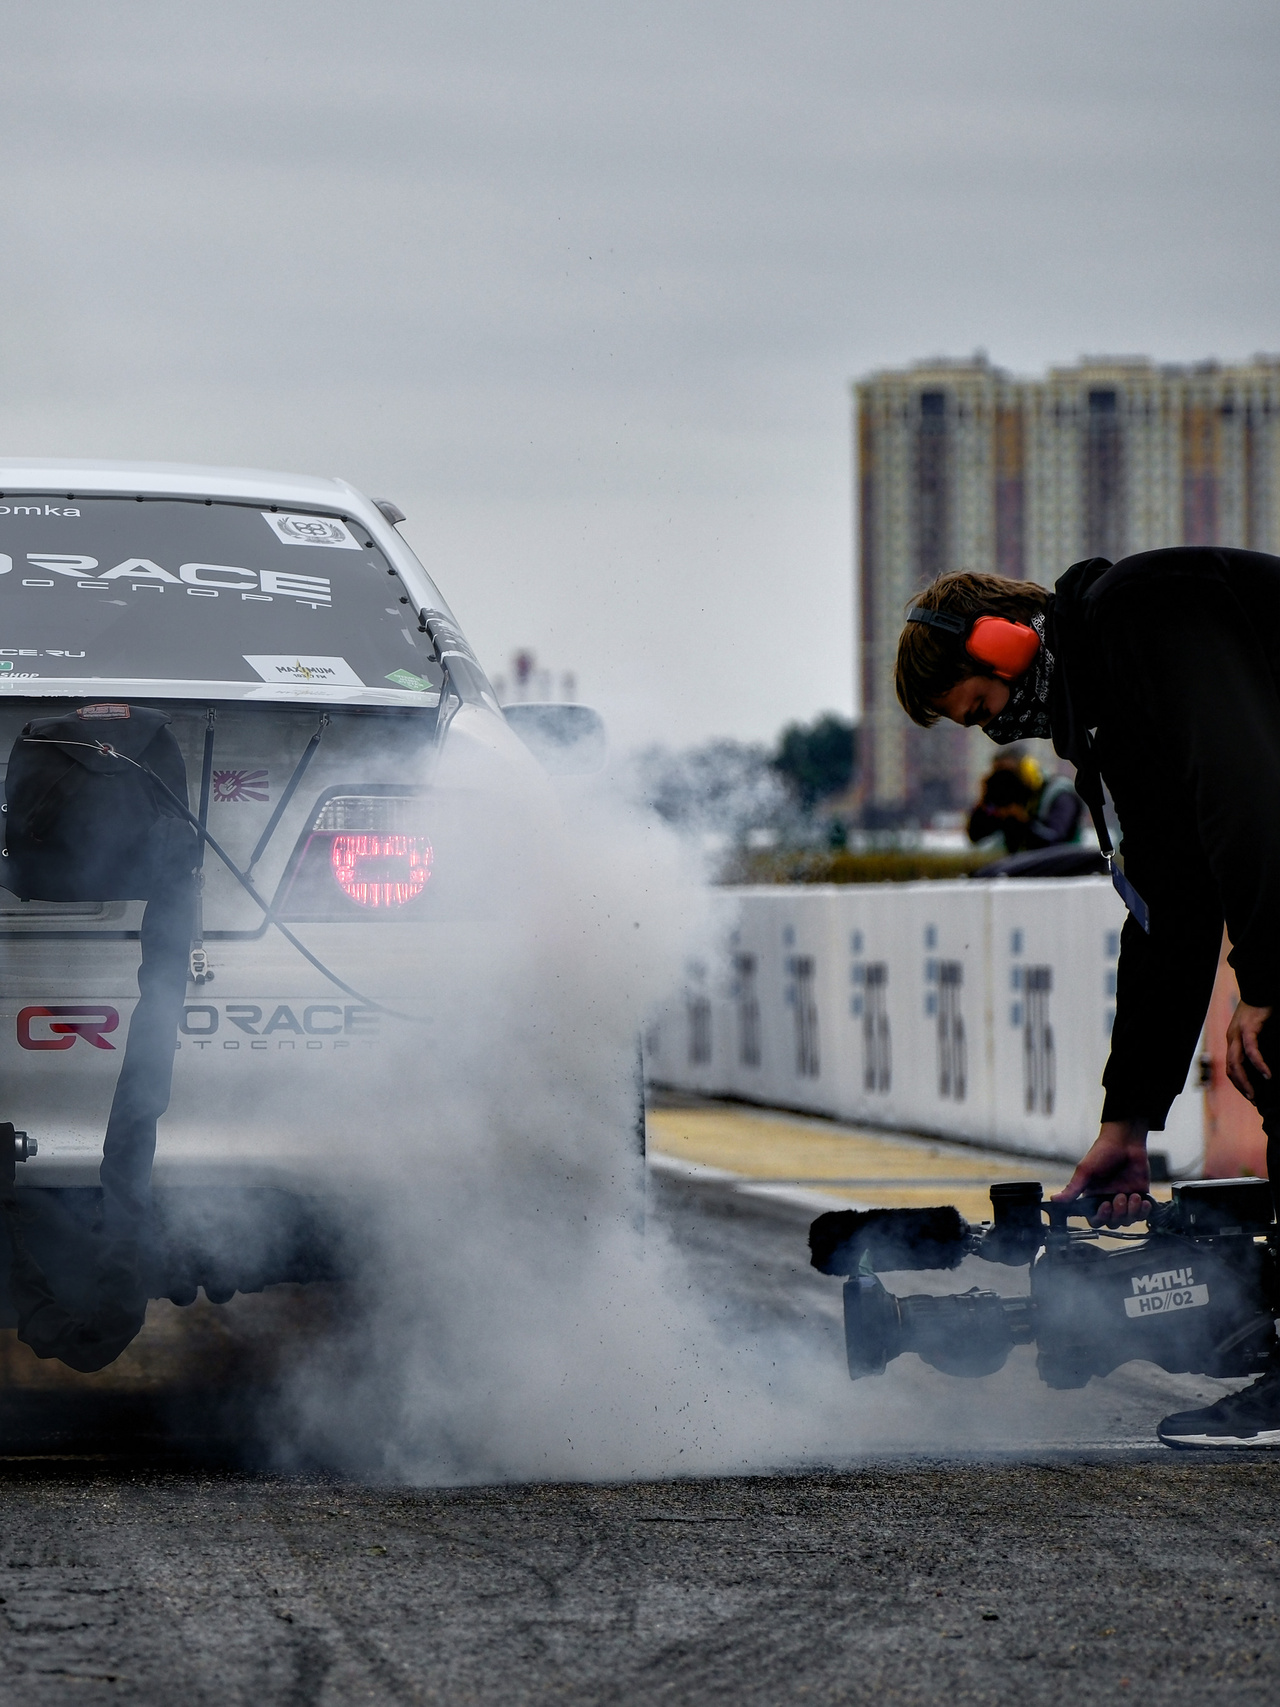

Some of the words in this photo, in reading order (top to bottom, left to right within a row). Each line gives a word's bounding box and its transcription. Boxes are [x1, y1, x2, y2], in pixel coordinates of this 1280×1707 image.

[26, 553, 332, 602] RACE
[275, 666, 336, 676] MAXIMUM
[16, 1005, 120, 1050] GR
[1139, 1291, 1194, 1313] HD//02
